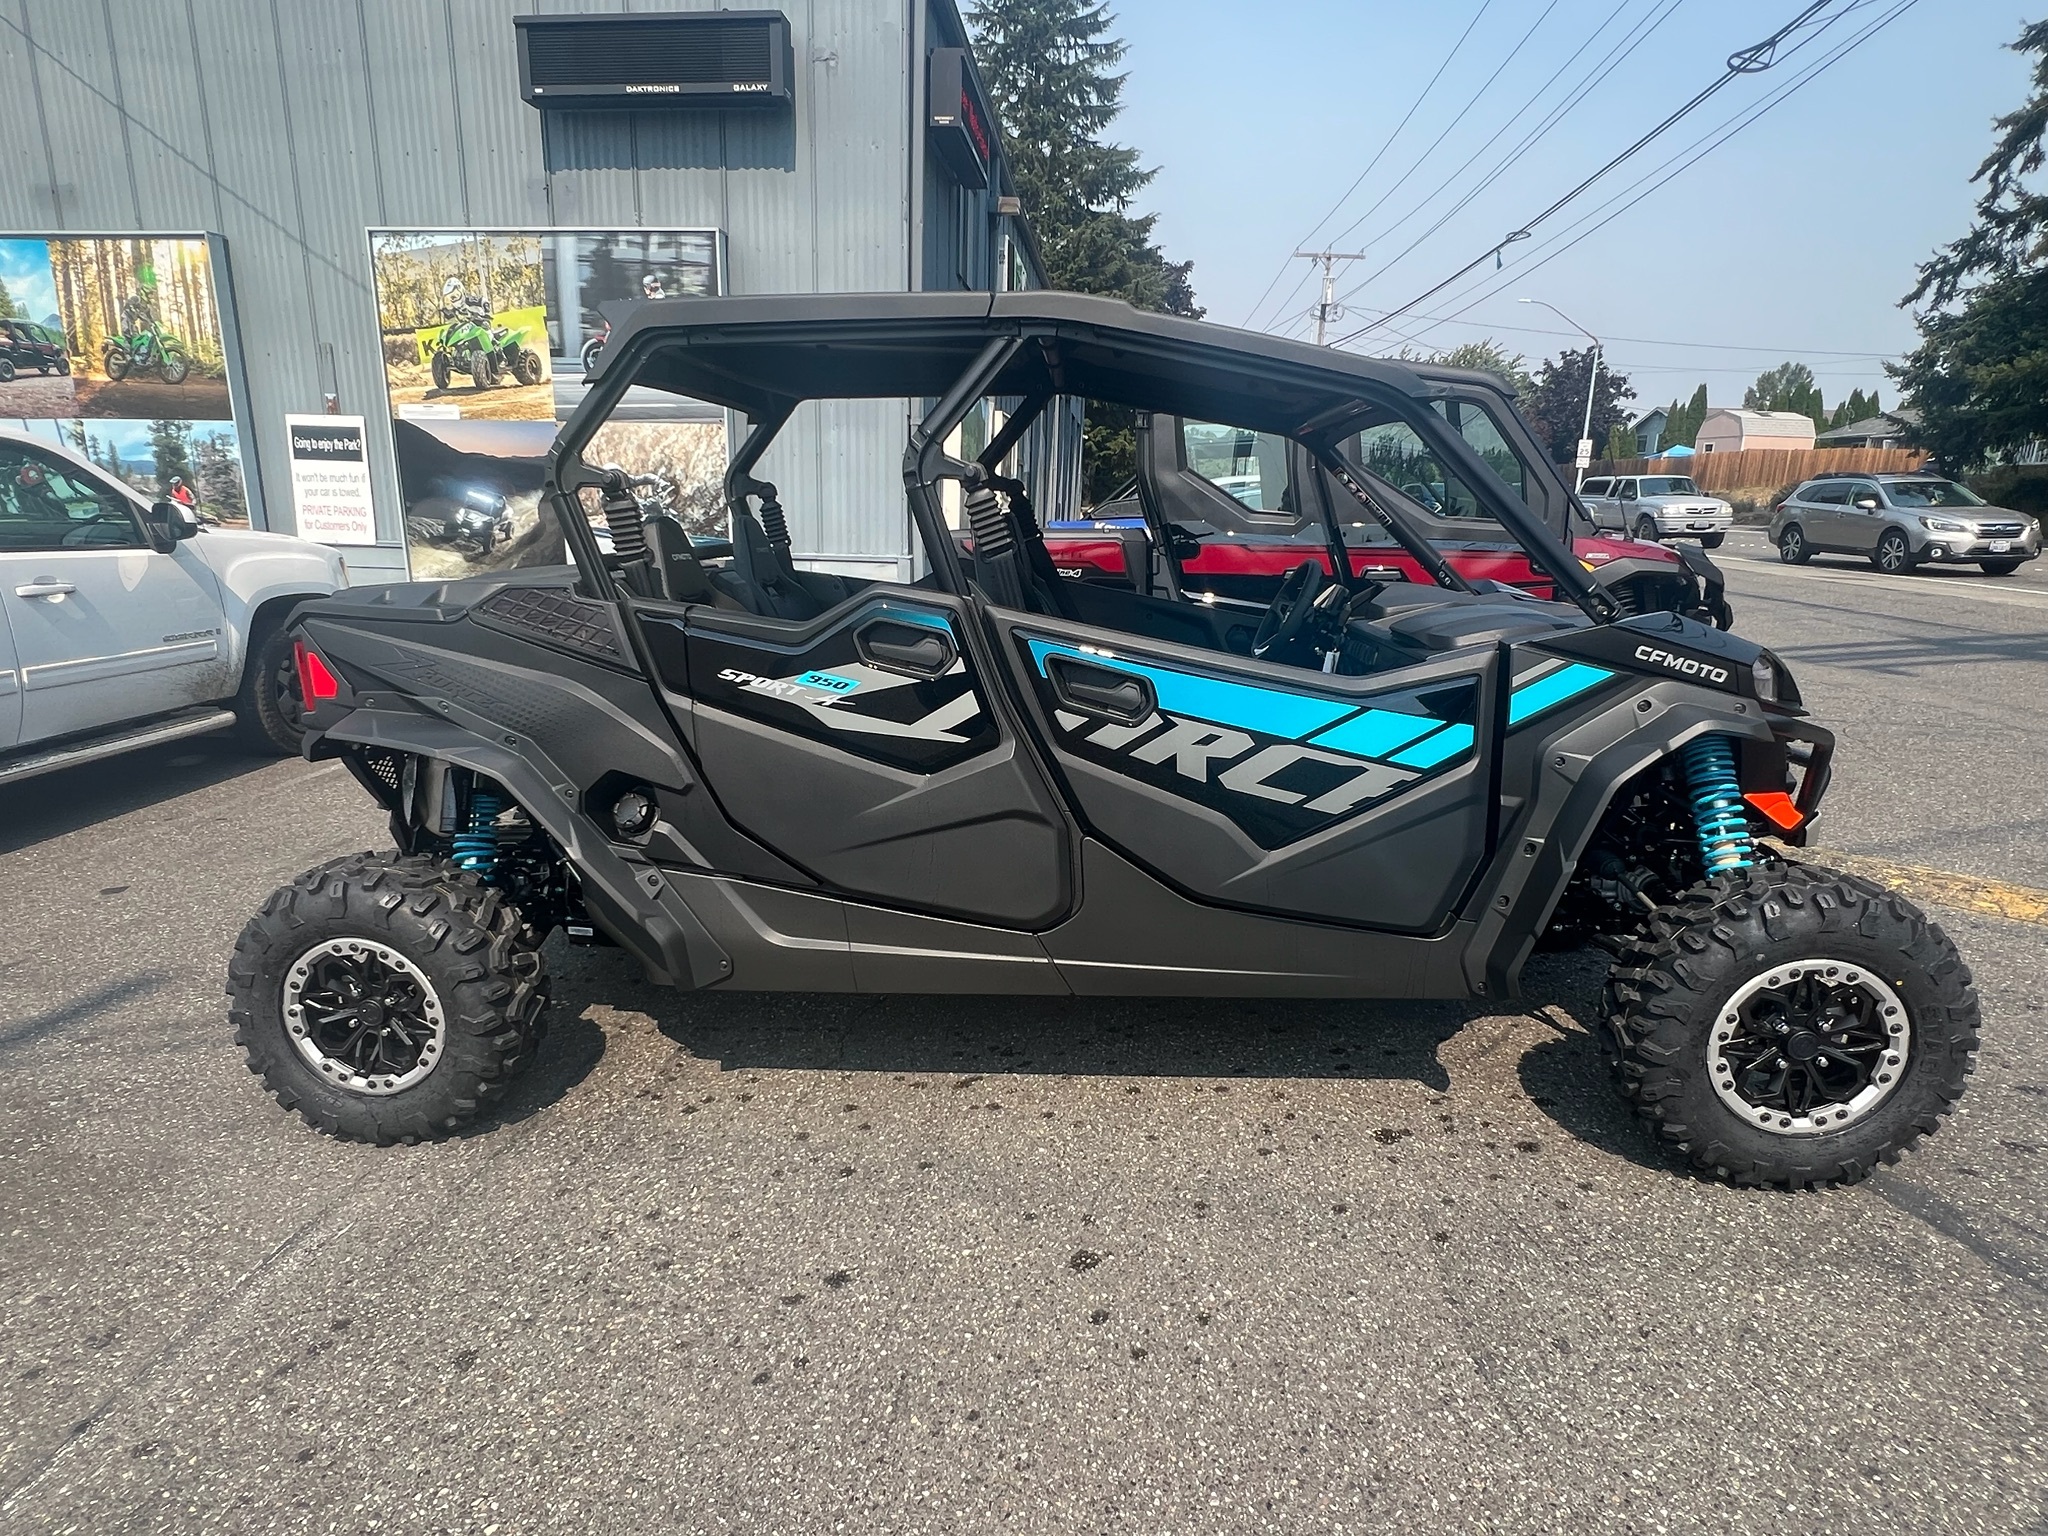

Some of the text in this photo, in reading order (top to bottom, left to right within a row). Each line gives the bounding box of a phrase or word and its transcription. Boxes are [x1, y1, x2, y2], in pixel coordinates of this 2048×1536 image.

[733, 83, 768, 92] GALAXY
[294, 436, 361, 453] Going to enjoy the Park?
[301, 472, 318, 483] won't
[319, 473, 328, 483] be
[330, 473, 348, 483] much
[349, 473, 360, 483] fun
[304, 488, 319, 499] your
[320, 488, 331, 497] car
[302, 504, 367, 518] PRIVATE PARKING
[304, 519, 368, 536] for Customers Only
[1635, 645, 1729, 683] CFMOTO
[717, 668, 807, 696] SPORT
[806, 675, 850, 690] 950
